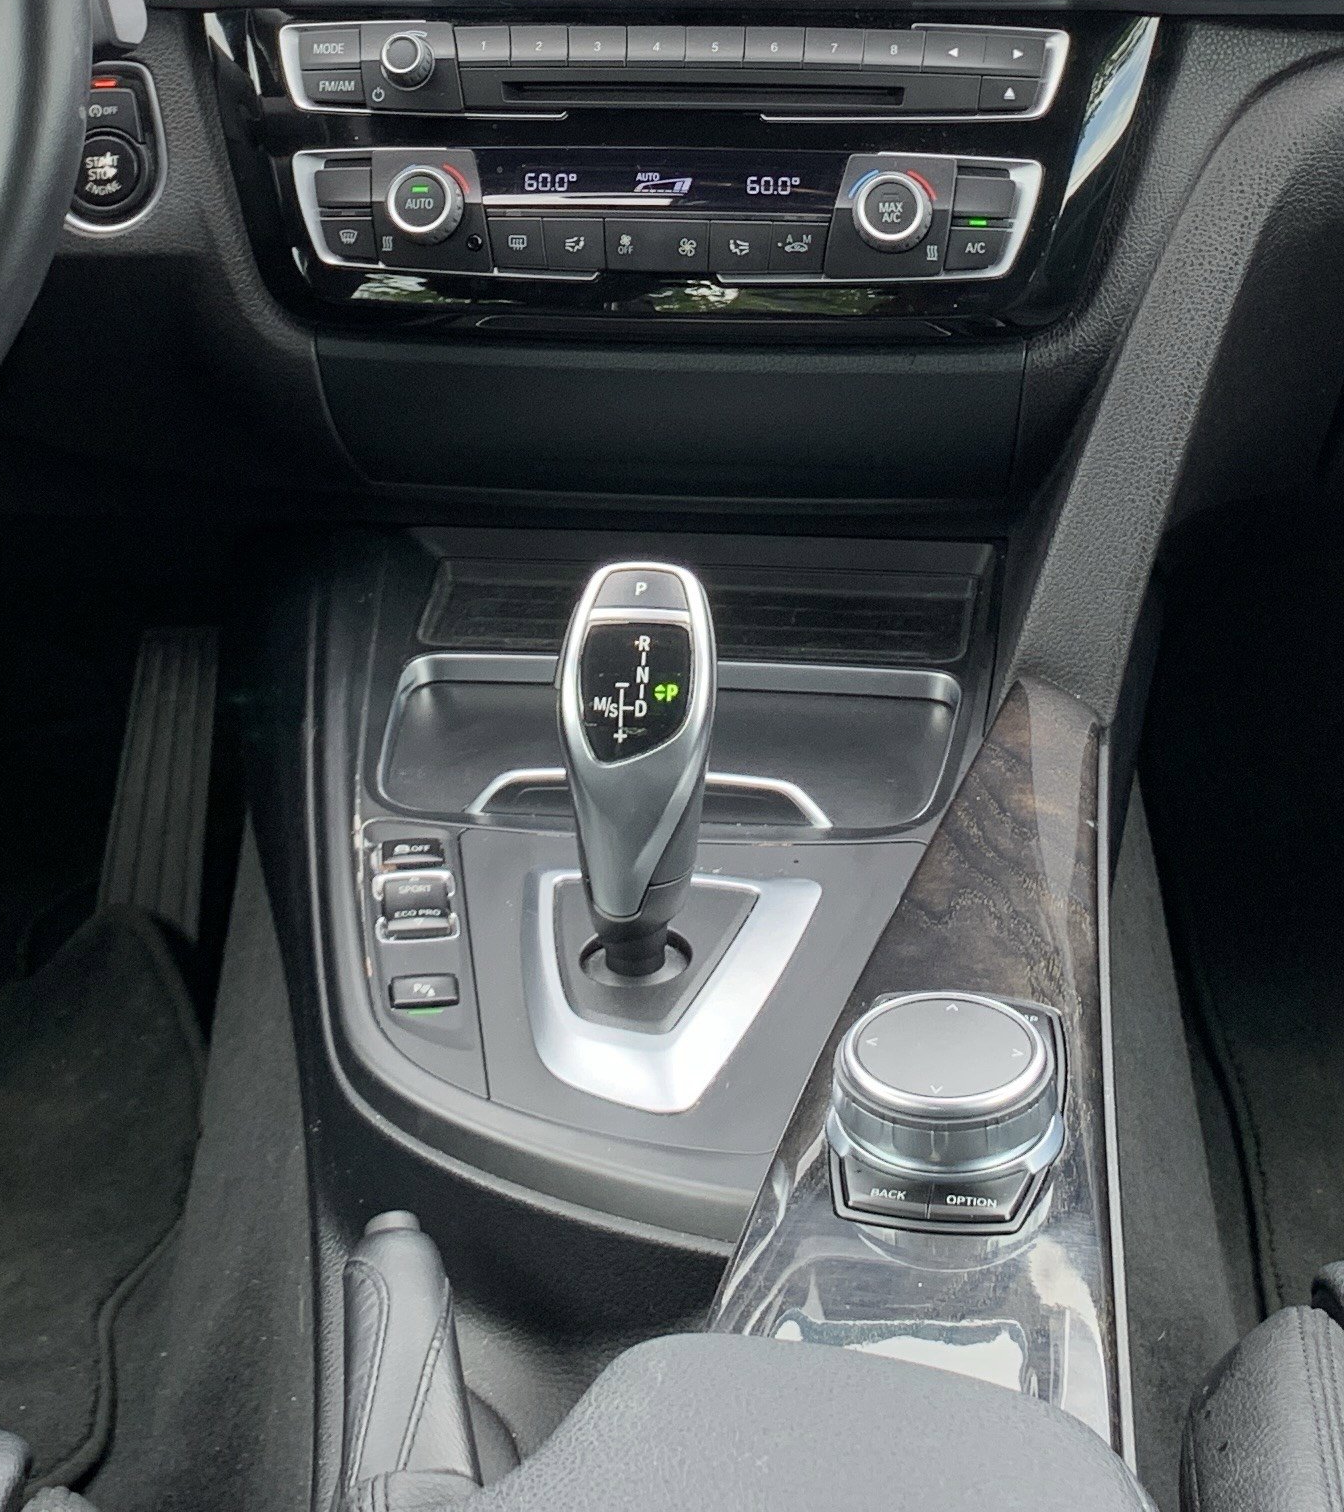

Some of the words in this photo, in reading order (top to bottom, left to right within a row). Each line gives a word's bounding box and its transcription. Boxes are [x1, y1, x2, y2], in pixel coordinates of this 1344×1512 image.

[313, 43, 344, 54] MODE
[481, 41, 487, 51] 1
[535, 41, 543, 52] 2
[594, 41, 602, 52] 3
[653, 41, 661, 52] 4
[711, 41, 719, 53] 5
[770, 42, 778, 53] 6
[830, 43, 838, 54] 7
[890, 44, 898, 56] 8
[319, 80, 355, 92] FM/AM
[103, 105, 119, 116] OFF
[636, 172, 660, 182] AUTO
[405, 198, 433, 210] AUTO
[878, 202, 903, 213] MAX
[881, 213, 901, 224] A/C
[618, 245, 633, 255] OFF
[965, 242, 985, 254] A/C
[635, 582, 647, 596] P
[638, 635, 651, 651] R
[636, 666, 649, 683] N
[666, 684, 678, 701] P
[634, 699, 647, 717] D
[410, 844, 430, 852] OFF
[398, 885, 432, 895] SPORT
[394, 909, 417, 918] ECO
[418, 908, 441, 917] PRO
[870, 1188, 906, 1200] BACK
[946, 1194, 997, 1208] OPTION
